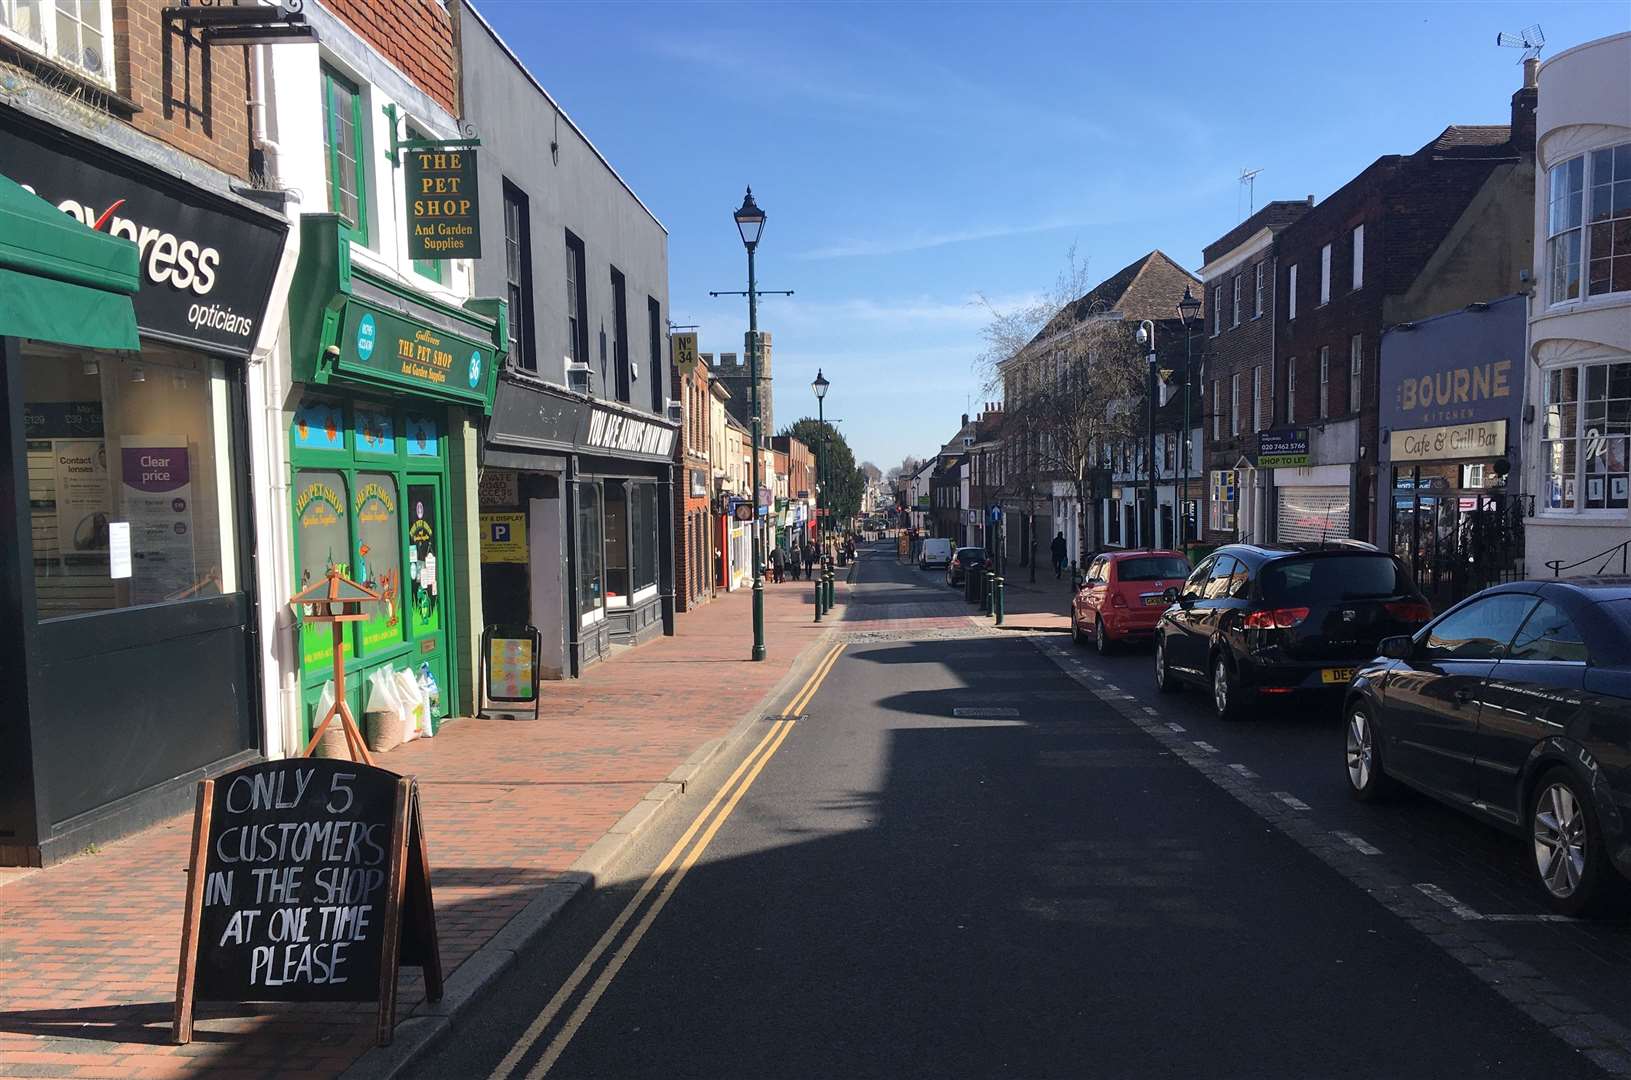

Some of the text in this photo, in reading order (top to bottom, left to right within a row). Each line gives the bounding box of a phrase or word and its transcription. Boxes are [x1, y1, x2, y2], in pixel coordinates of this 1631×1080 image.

[419, 154, 462, 170] THE
[422, 177, 461, 193] PET
[414, 200, 471, 216] SHOP
[415, 223, 473, 235] And Garden
[424, 237, 465, 251] Supplies
[188, 303, 252, 336] opticians
[399, 339, 453, 369] THE PET SHOP
[679, 351, 693, 364] 34
[1402, 360, 1511, 410] BOURNE
[588, 409, 607, 447] YOU
[1404, 427, 1498, 456] Cafe & Grill Bar
[60, 456, 92, 465] Contact
[141, 455, 170, 467] Clear
[1260, 455, 1307, 465] SHOP TO LET
[142, 469, 170, 484] price
[496, 514, 523, 522] DISPLAY
[495, 525, 506, 540] P
[226, 768, 357, 814] ONLY 5
[216, 821, 387, 866] CUSTOMERS
[205, 867, 385, 906] IN THE SHOP
[219, 904, 372, 947] AT ONE TIME
[250, 942, 351, 986] PLEASE
